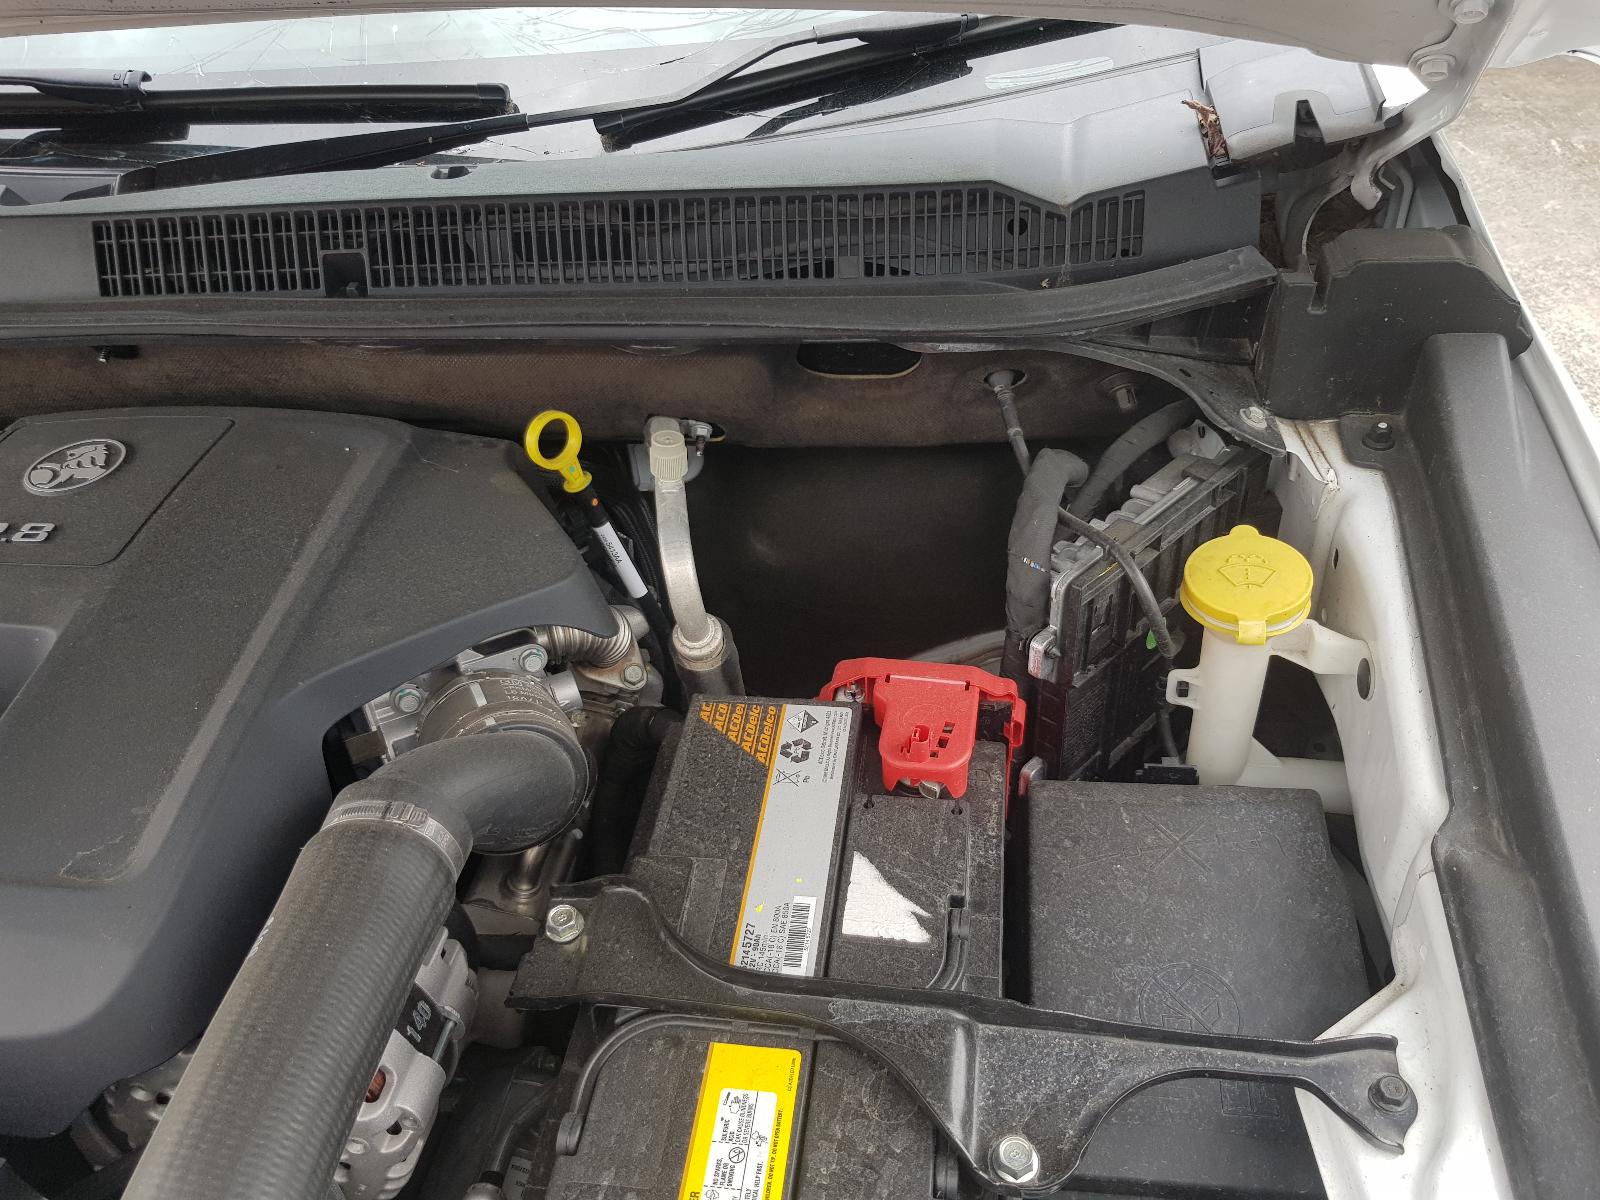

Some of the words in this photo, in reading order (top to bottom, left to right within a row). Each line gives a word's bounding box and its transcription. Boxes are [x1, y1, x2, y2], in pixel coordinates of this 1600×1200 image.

[0, 523, 56, 541] .8
[714, 703, 728, 731] ACD
[756, 705, 776, 764] ACDelco
[407, 1000, 431, 1043] 140
[727, 1164, 736, 1187] SMOKING
